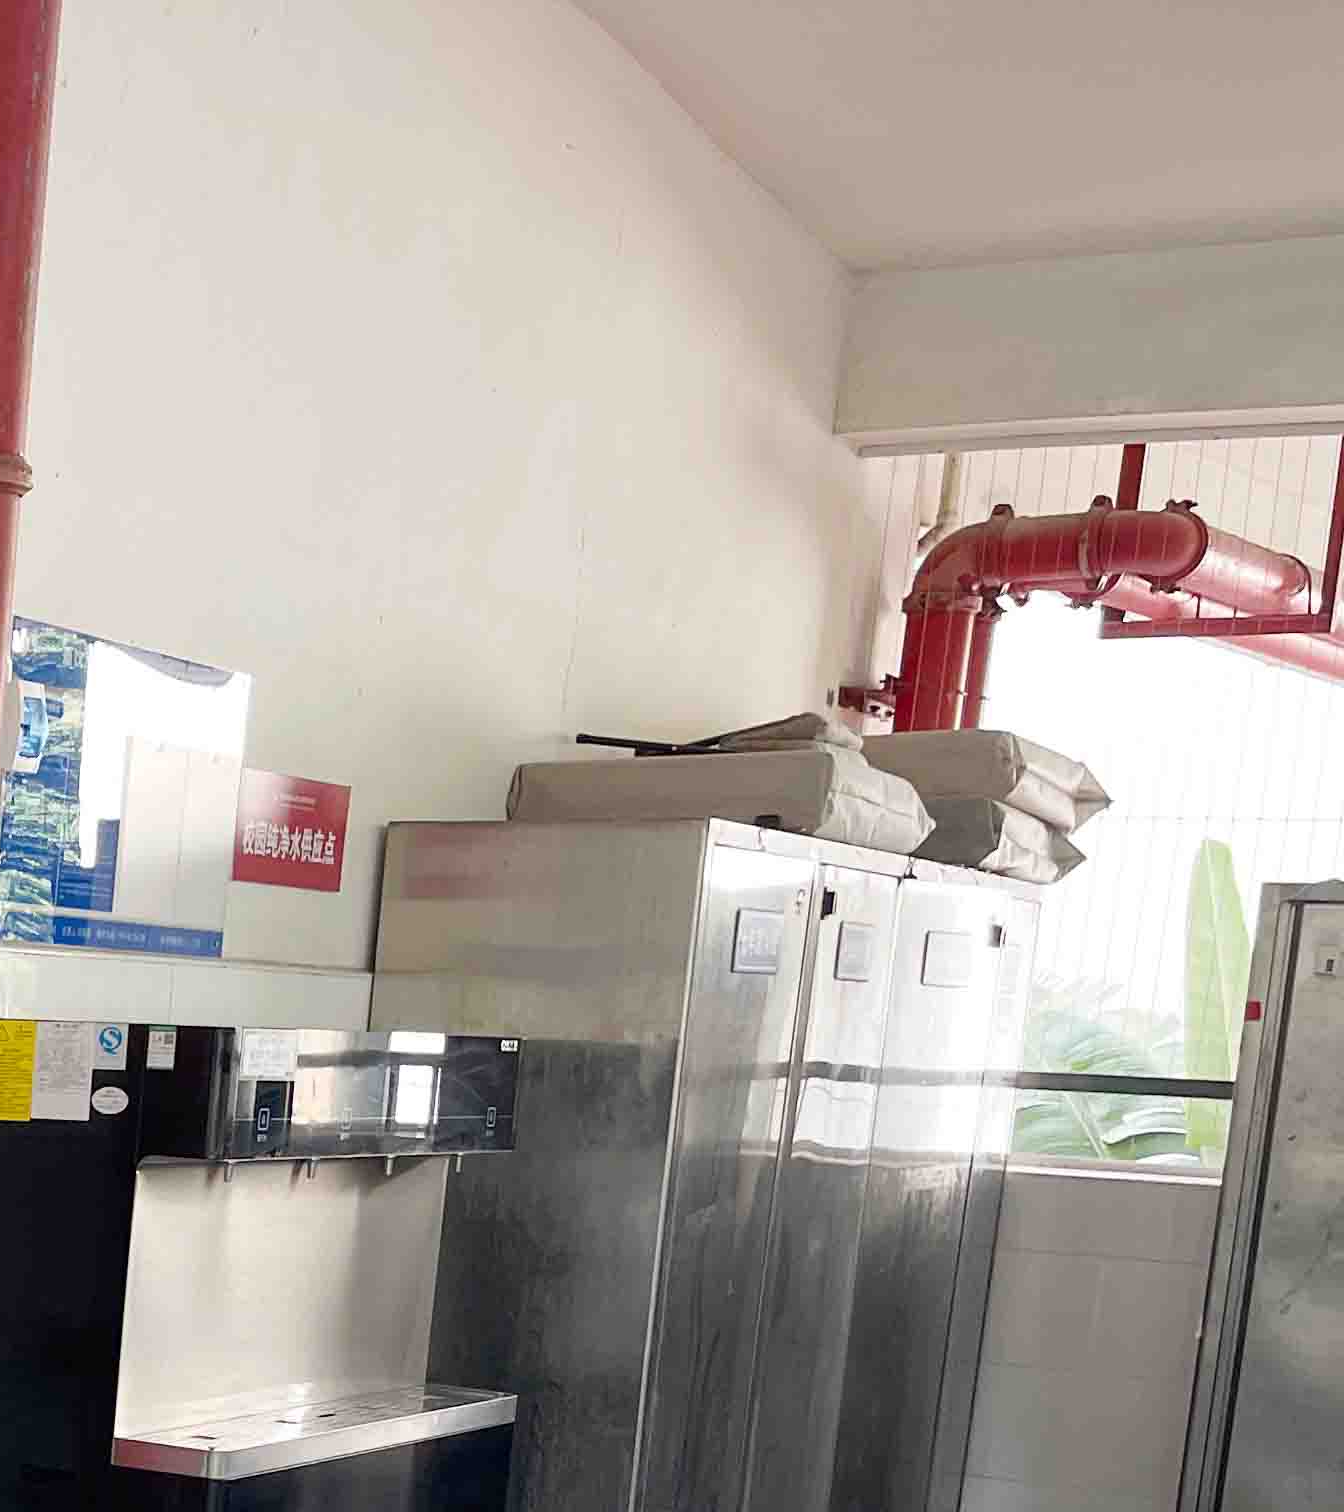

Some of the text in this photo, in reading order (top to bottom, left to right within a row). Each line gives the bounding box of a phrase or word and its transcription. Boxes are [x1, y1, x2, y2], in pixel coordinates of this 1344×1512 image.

[241, 820, 336, 864] 校园纯净水供应点
